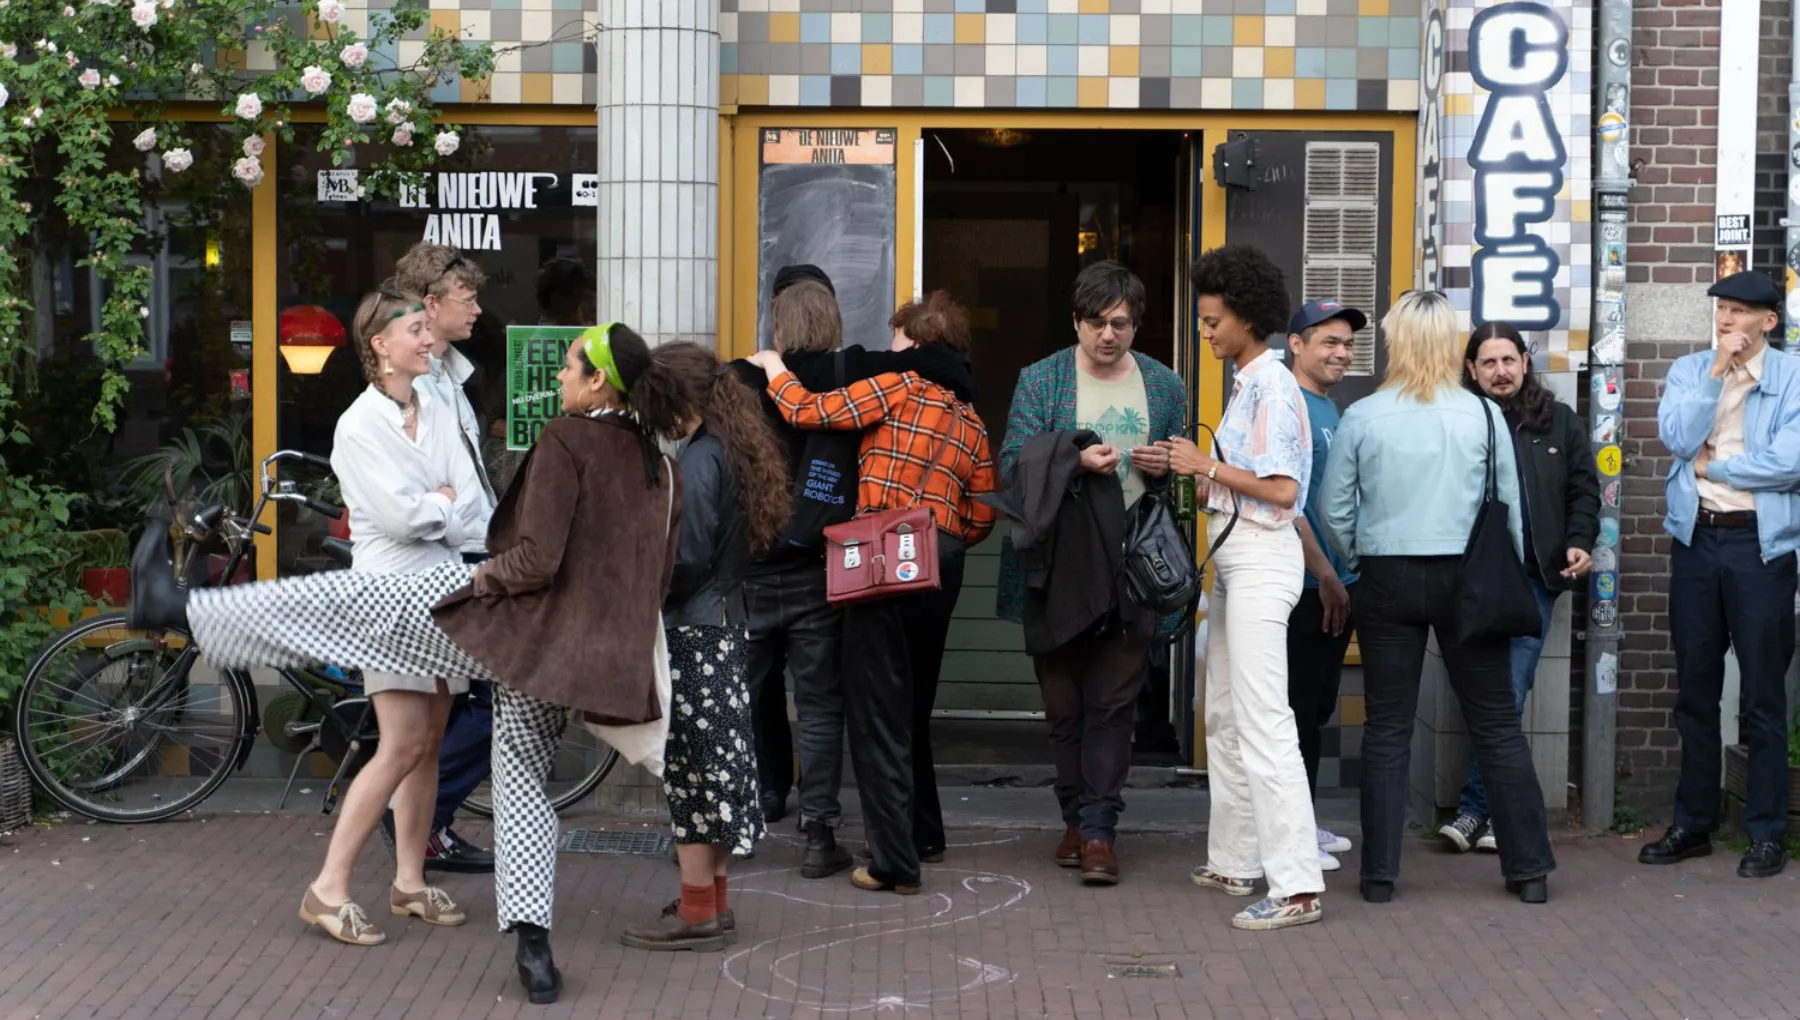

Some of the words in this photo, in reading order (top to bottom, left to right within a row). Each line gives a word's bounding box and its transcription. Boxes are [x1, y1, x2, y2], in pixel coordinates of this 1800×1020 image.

[816, 129, 860, 146] NIEUWE
[811, 148, 845, 164] ANITA
[438, 171, 558, 209] NIEUWE
[423, 213, 502, 250] ANITA
[1718, 216, 1745, 228] BEST
[527, 366, 562, 391] HE
[514, 393, 566, 419] LEU
[514, 421, 545, 446] BO
[806, 479, 834, 492] GIANT
